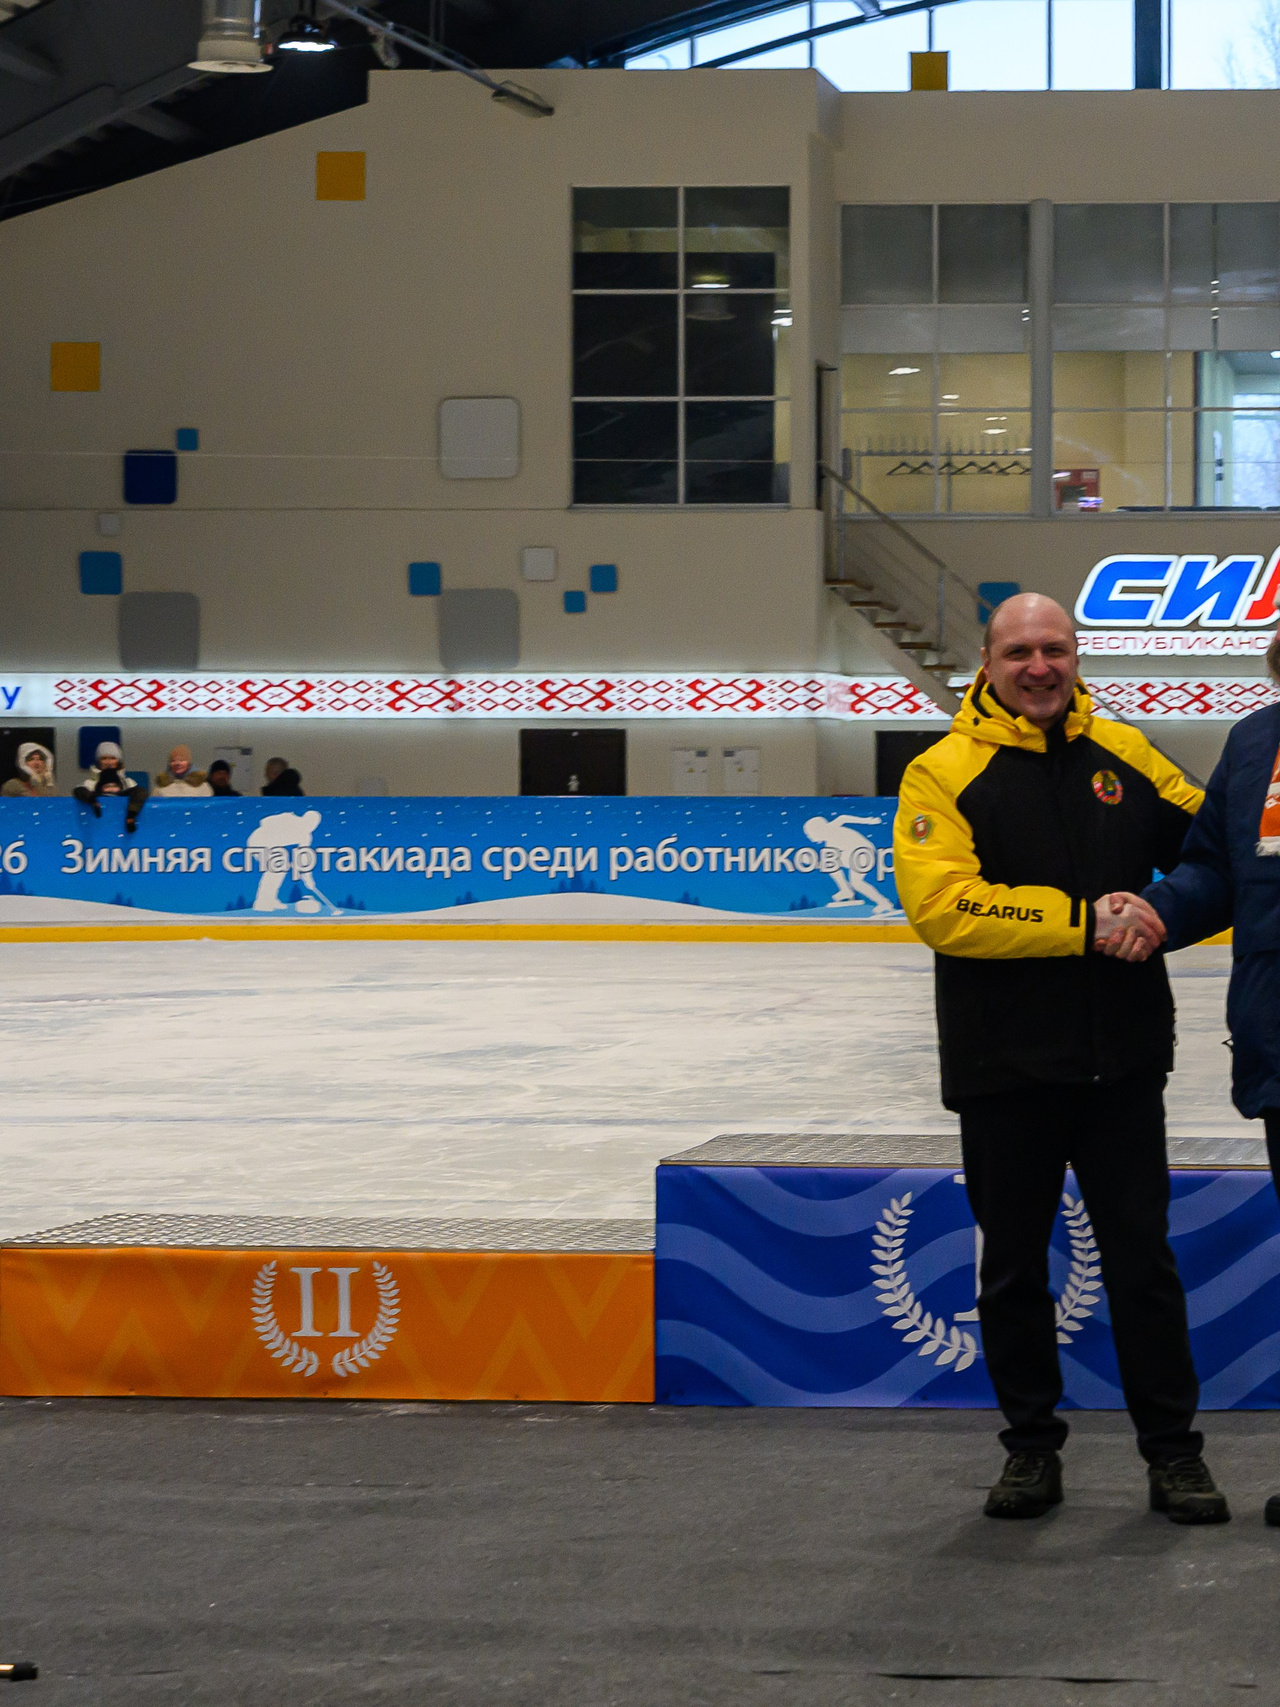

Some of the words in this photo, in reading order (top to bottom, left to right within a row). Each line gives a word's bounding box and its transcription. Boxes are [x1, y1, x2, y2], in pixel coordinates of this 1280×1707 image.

[0, 840, 28, 875] 6
[60, 838, 211, 874] Зимняя
[222, 845, 472, 881] спартакиада
[481, 845, 599, 881] среди
[609, 835, 841, 881] работников
[289, 1266, 361, 1338] II
